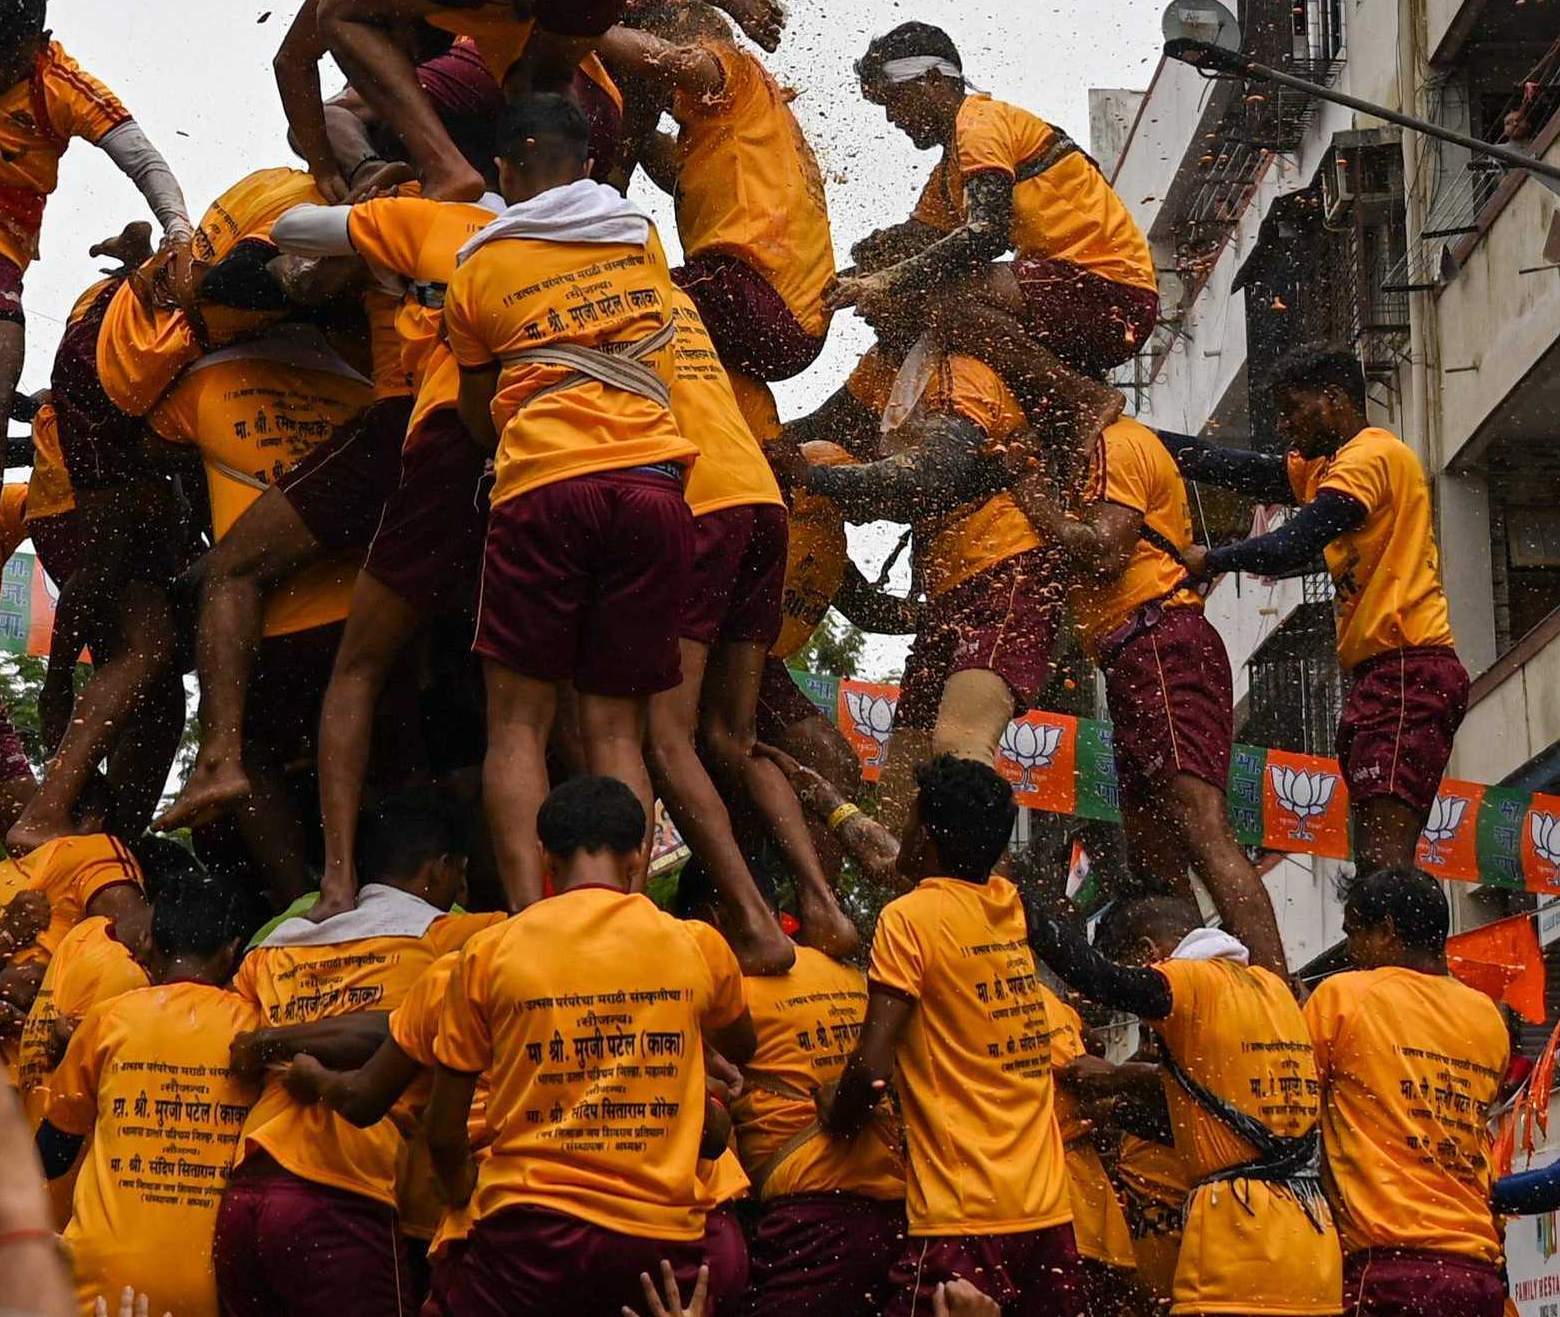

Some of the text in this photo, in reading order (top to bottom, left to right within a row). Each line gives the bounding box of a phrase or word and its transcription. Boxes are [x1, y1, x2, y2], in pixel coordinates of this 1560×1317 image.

[577, 265, 602, 282] मराठी
[547, 306, 569, 333] श्री.
[567, 297, 598, 332] मुरजी
[595, 290, 623, 318] पटेल
[625, 286, 664, 314] (काका)
[556, 994, 594, 1007] परंपरेचा
[598, 990, 626, 1005] मराठी
[630, 988, 681, 1004] संस्कृतीचा
[549, 1024, 685, 1069] श्री. मुरजी पटेल (काका)
[113, 1098, 128, 1118] मा.
[134, 1089, 151, 1118] श्री.
[155, 1093, 182, 1128] मुरजी
[185, 1094, 211, 1123] पटेल
[525, 1109, 544, 1124] मा.
[549, 1102, 567, 1124] श्री.
[601, 1097, 647, 1121] सिताराम
[111, 1153, 216, 1179] मा. श्री. संदिप सिताराम
[1515, 1279, 1537, 1302] FAMILY
